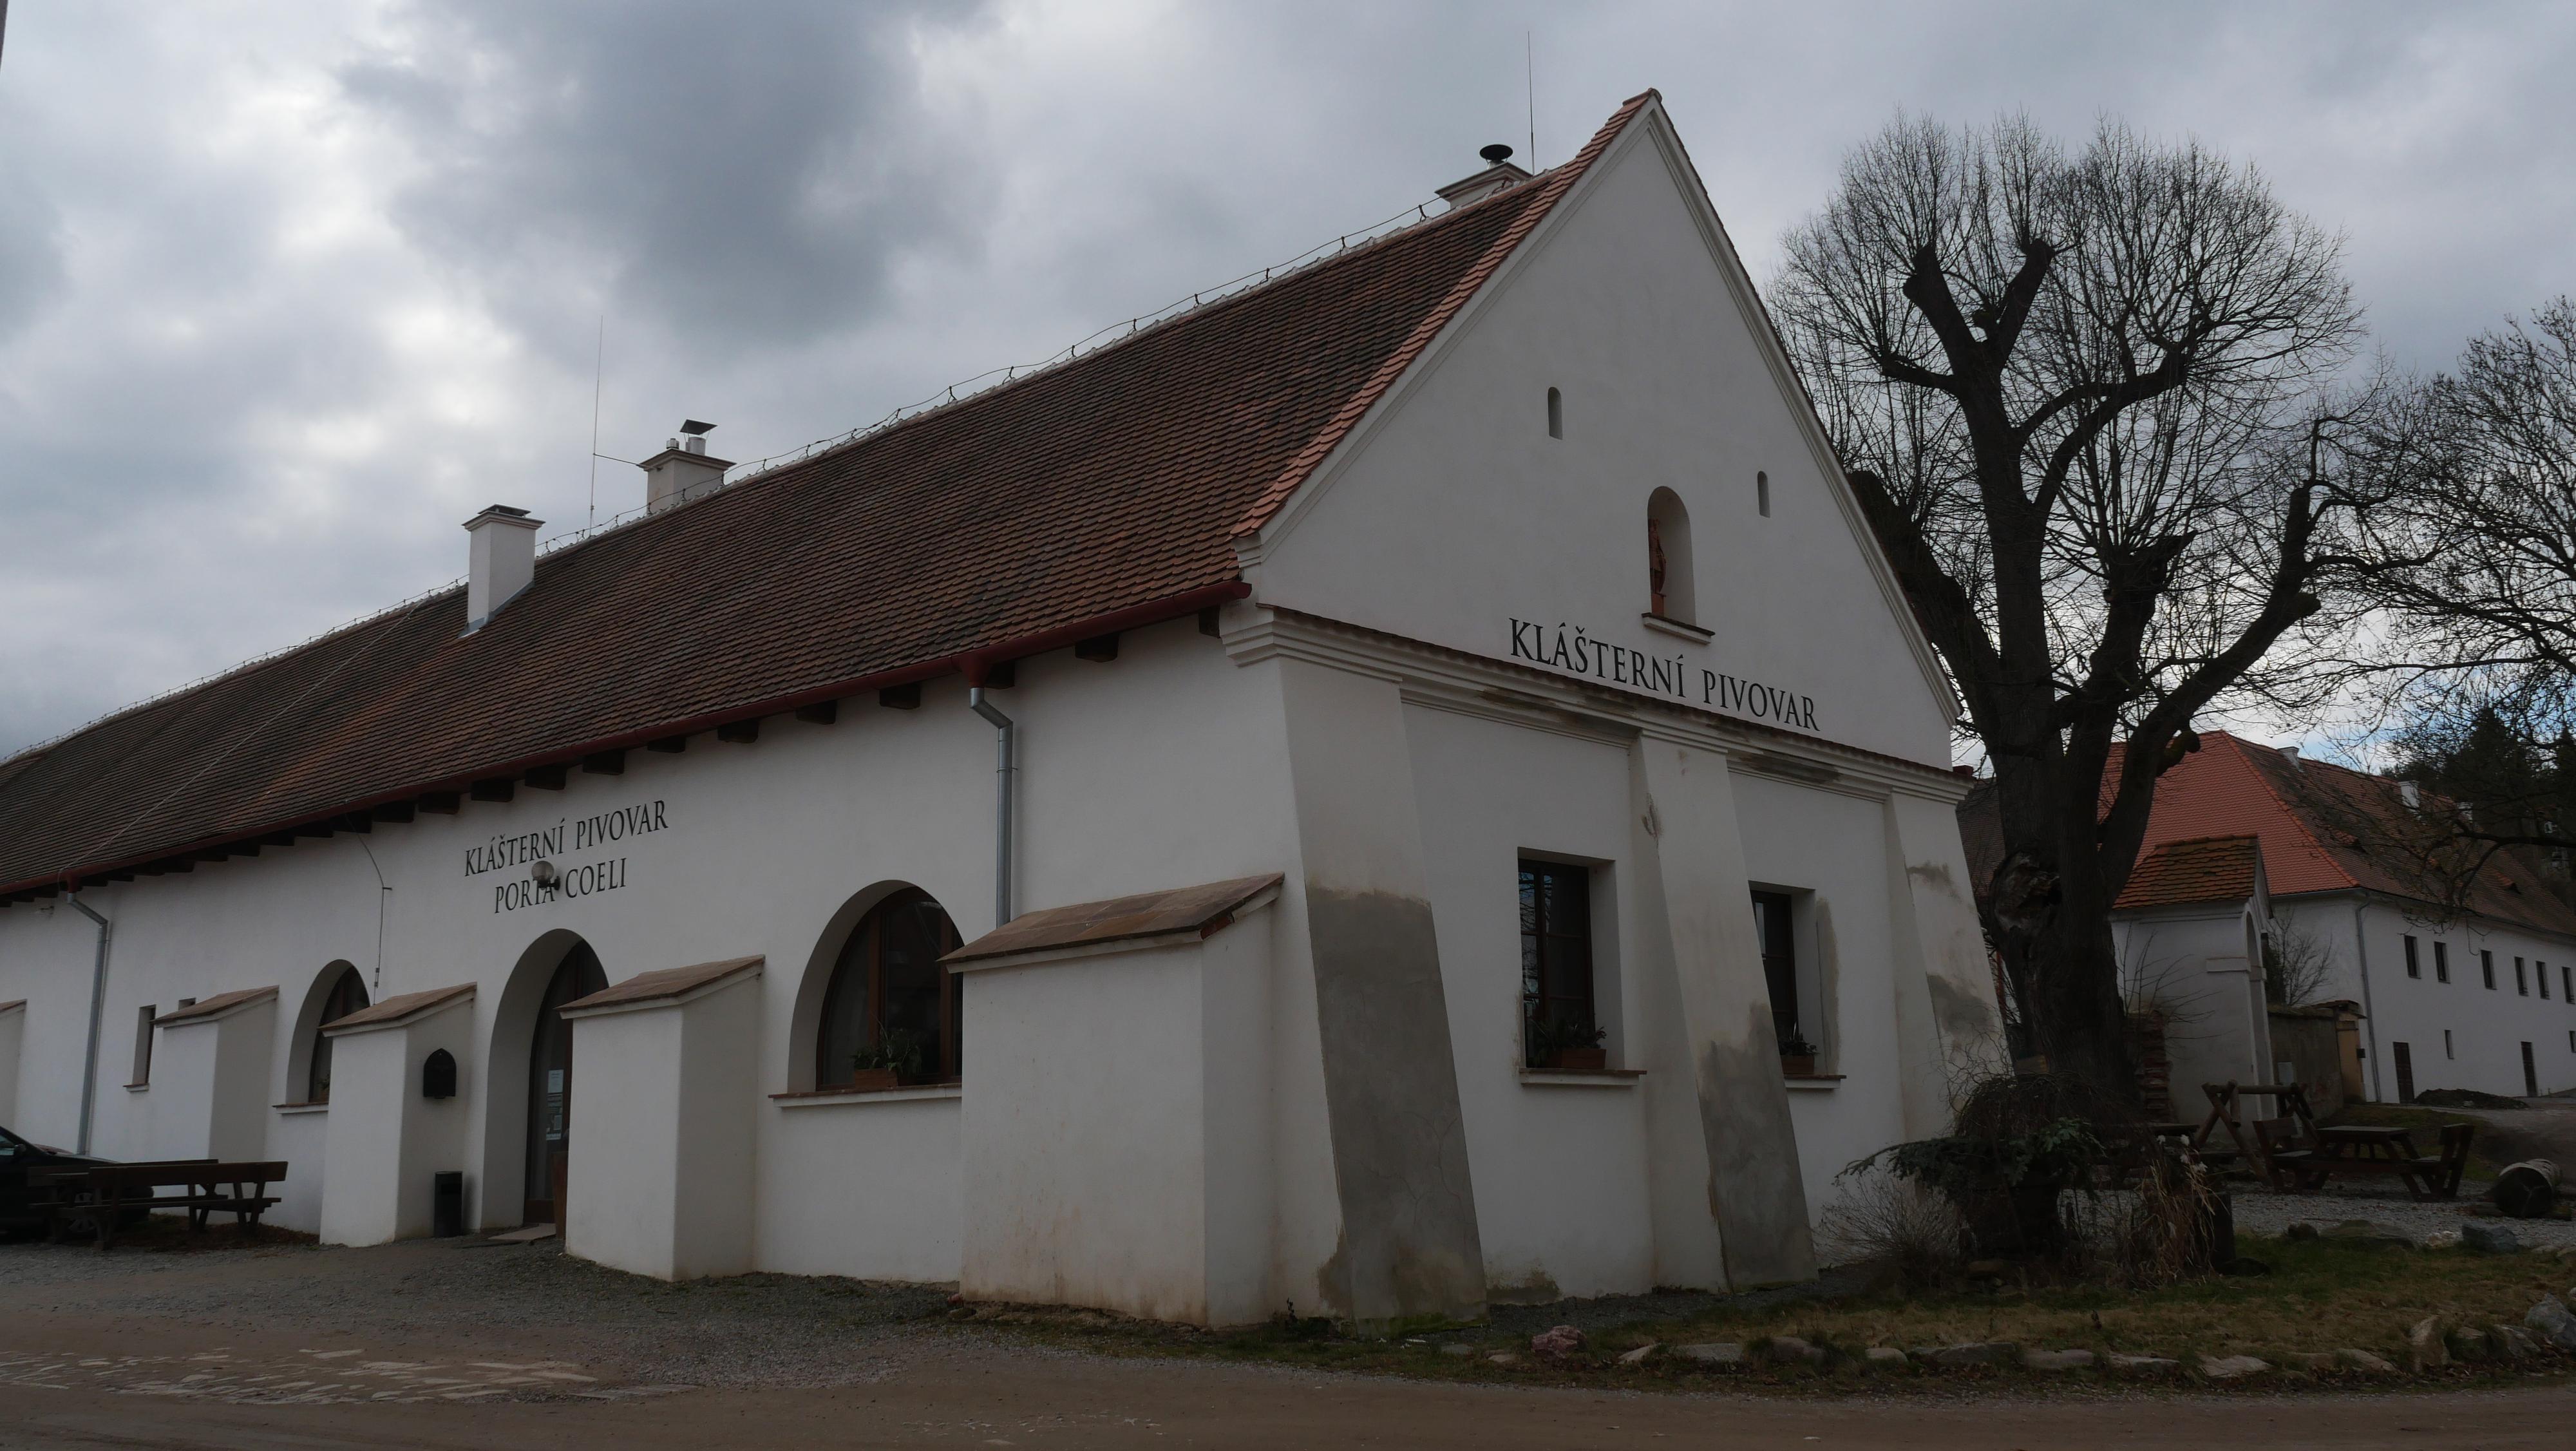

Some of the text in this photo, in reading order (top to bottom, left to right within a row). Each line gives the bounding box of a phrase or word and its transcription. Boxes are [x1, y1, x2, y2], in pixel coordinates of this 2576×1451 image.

[1509, 618, 1820, 732] KLÁŠTERNÍ PIVOVAR
[464, 799, 669, 877] KLÁŠTERNÍ PIVOVAR
[565, 857, 627, 898] COELI
